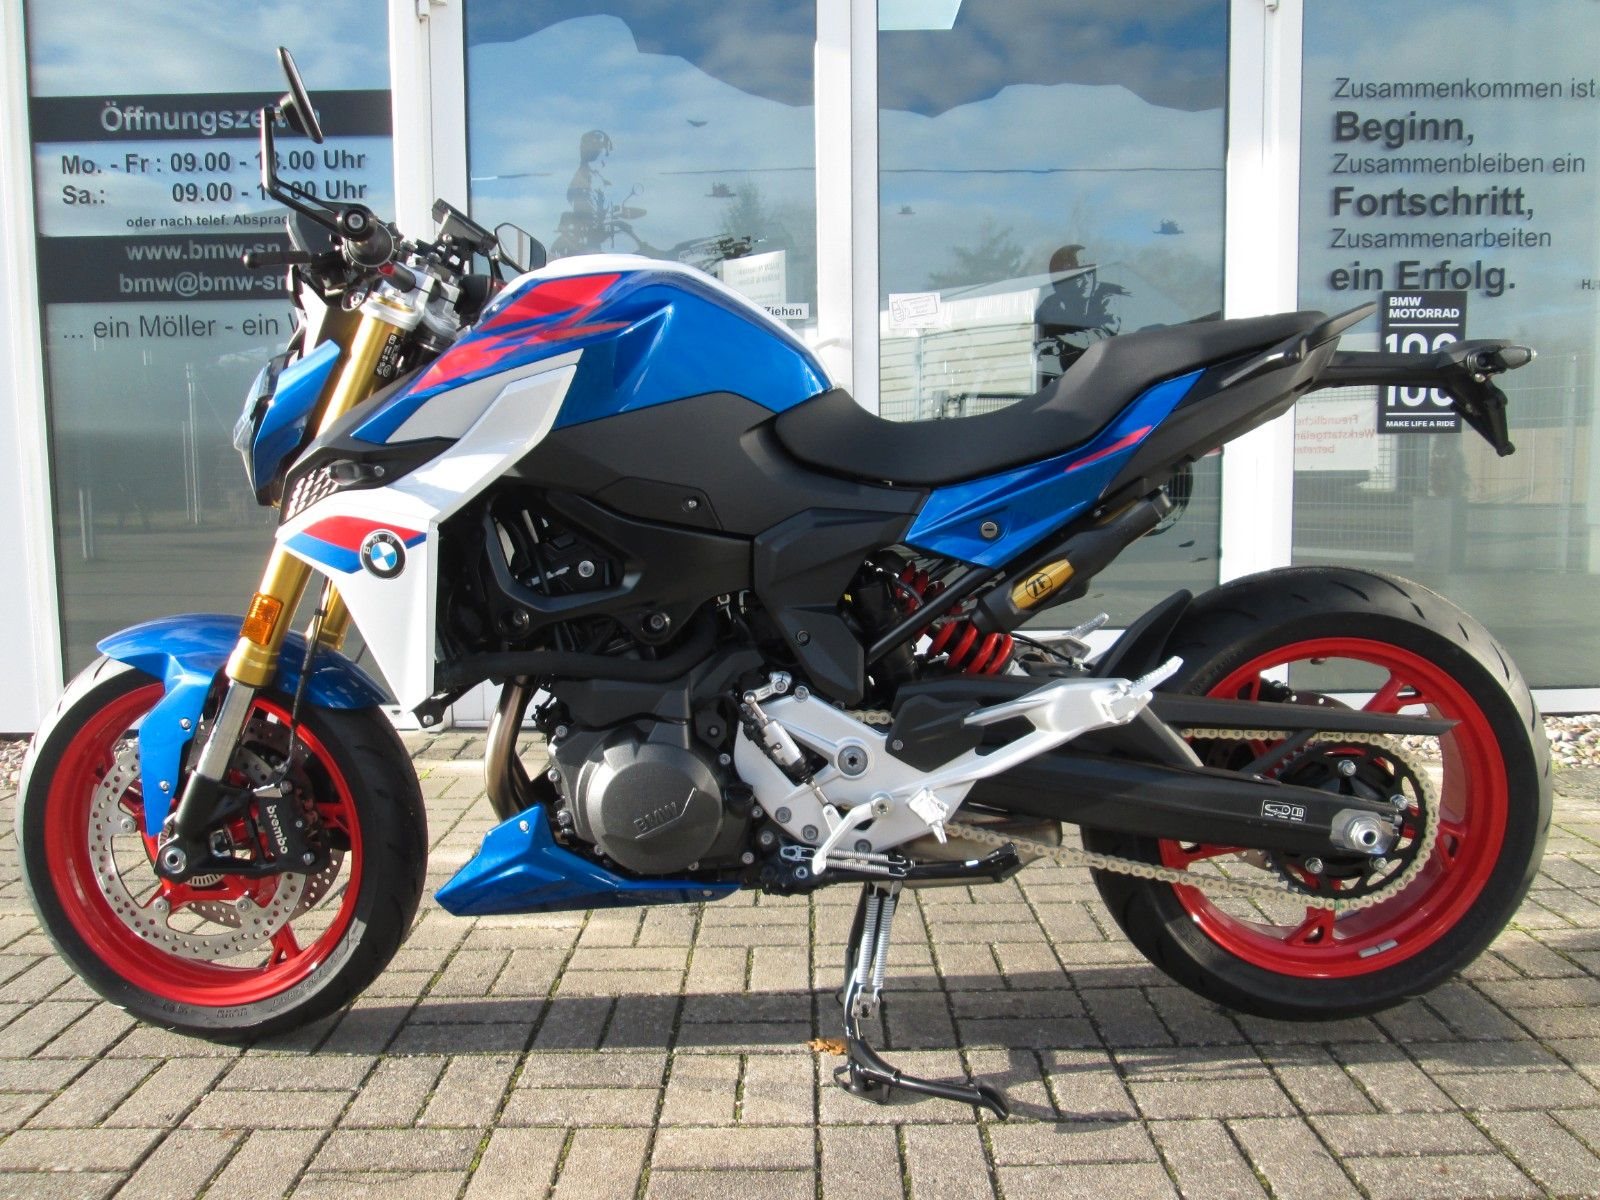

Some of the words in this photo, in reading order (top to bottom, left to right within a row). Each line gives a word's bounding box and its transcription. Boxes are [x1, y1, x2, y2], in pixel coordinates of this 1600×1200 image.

[1334, 77, 1562, 99] Zusammenkommen
[1571, 77, 1596, 98] ist
[101, 101, 320, 136] Öffnungsze
[1335, 110, 1475, 149] Beginn,
[61, 155, 101, 175] Mo.
[170, 152, 231, 172] 09.00
[324, 149, 366, 169] Uhr
[1332, 152, 1544, 174] Zusammenbleiben
[1552, 153, 1585, 173] ein
[172, 182, 233, 202] 09.00
[325, 180, 367, 200] Uhr
[1333, 185, 1535, 221] Fortschritt,
[126, 216, 156, 228] oder
[161, 215, 192, 227] nach
[197, 214, 230, 226] telef.
[1331, 227, 1552, 249] Zusammenarbeiten
[1330, 260, 1384, 291] ein
[1397, 260, 1516, 297] Erfolg.
[1389, 296, 1422, 307] BMW
[1388, 308, 1460, 319] MOTORRAD
[93, 317, 129, 339] ein
[140, 313, 217, 338] Möller
[242, 313, 279, 336] ein
[1386, 420, 1410, 428] MAKE
[1411, 420, 1428, 428] LIFE
[1429, 420, 1435, 428] A
[1436, 420, 1456, 428] RIDE
[364, 535, 395, 555] BMW
[266, 804, 289, 854] brembo
